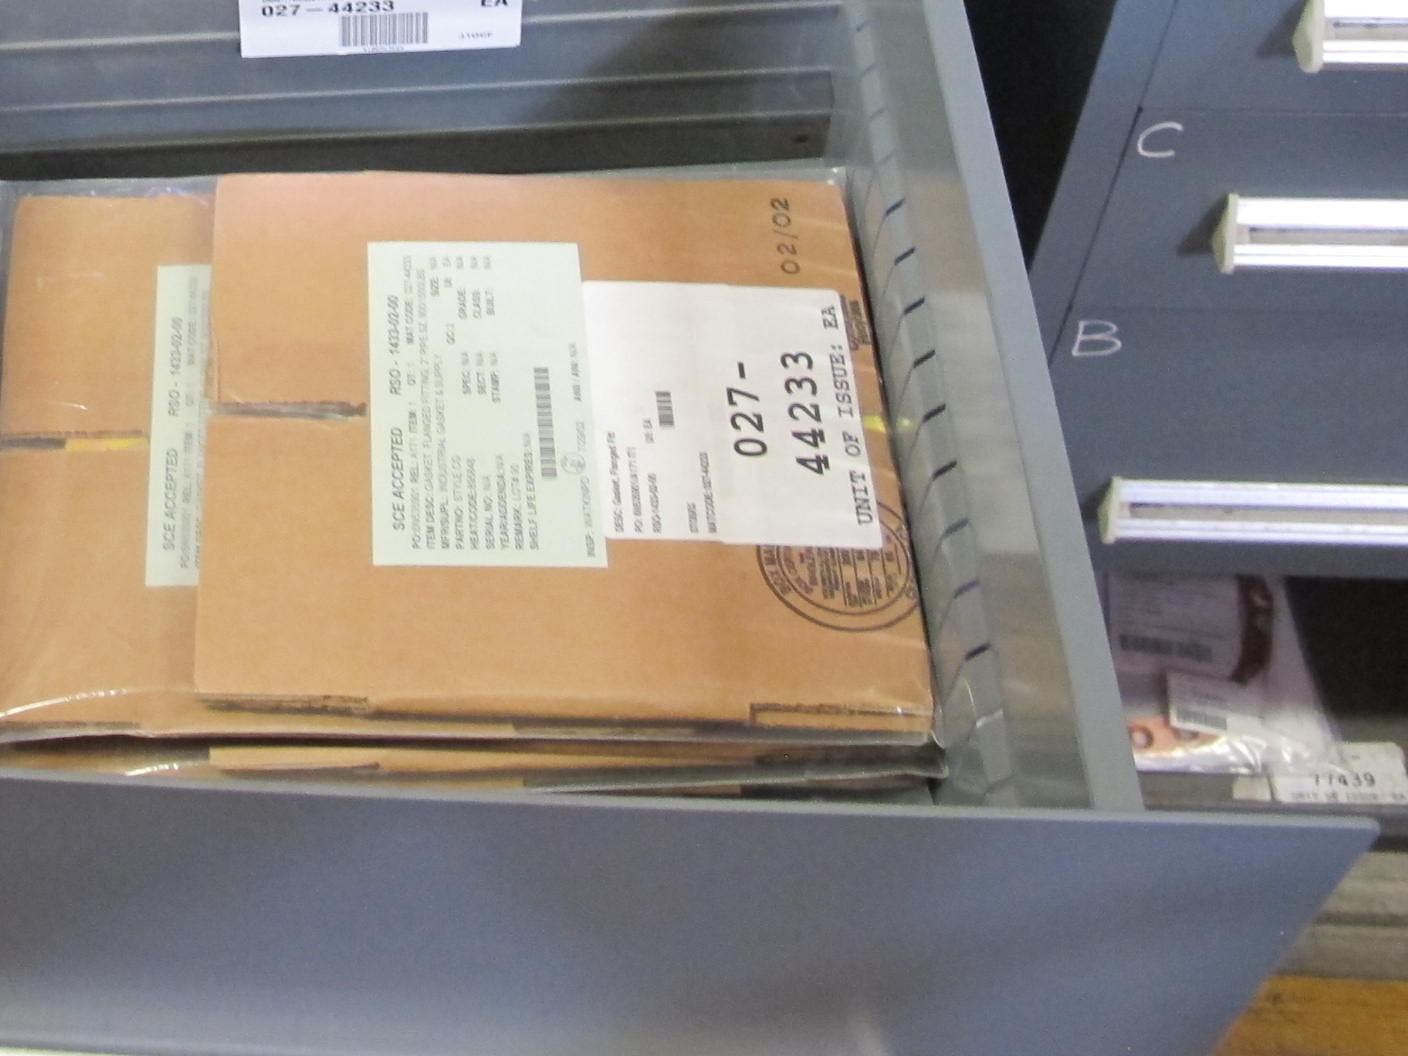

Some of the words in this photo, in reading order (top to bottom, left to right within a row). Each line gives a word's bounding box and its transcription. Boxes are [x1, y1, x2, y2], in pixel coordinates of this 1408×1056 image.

[1137, 122, 1183, 157] C
[822, 305, 838, 331] EA
[1072, 319, 1123, 356] B
[388, 368, 401, 395] RSO
[830, 344, 855, 419] ISSUE:
[726, 361, 768, 458] 027-
[780, 350, 831, 478] 44233
[390, 426, 404, 499] ACCEPTED
[837, 430, 861, 458] OF
[163, 447, 178, 519] ACCEPTED
[848, 470, 873, 526] UNIT
[391, 502, 405, 530] SCE
